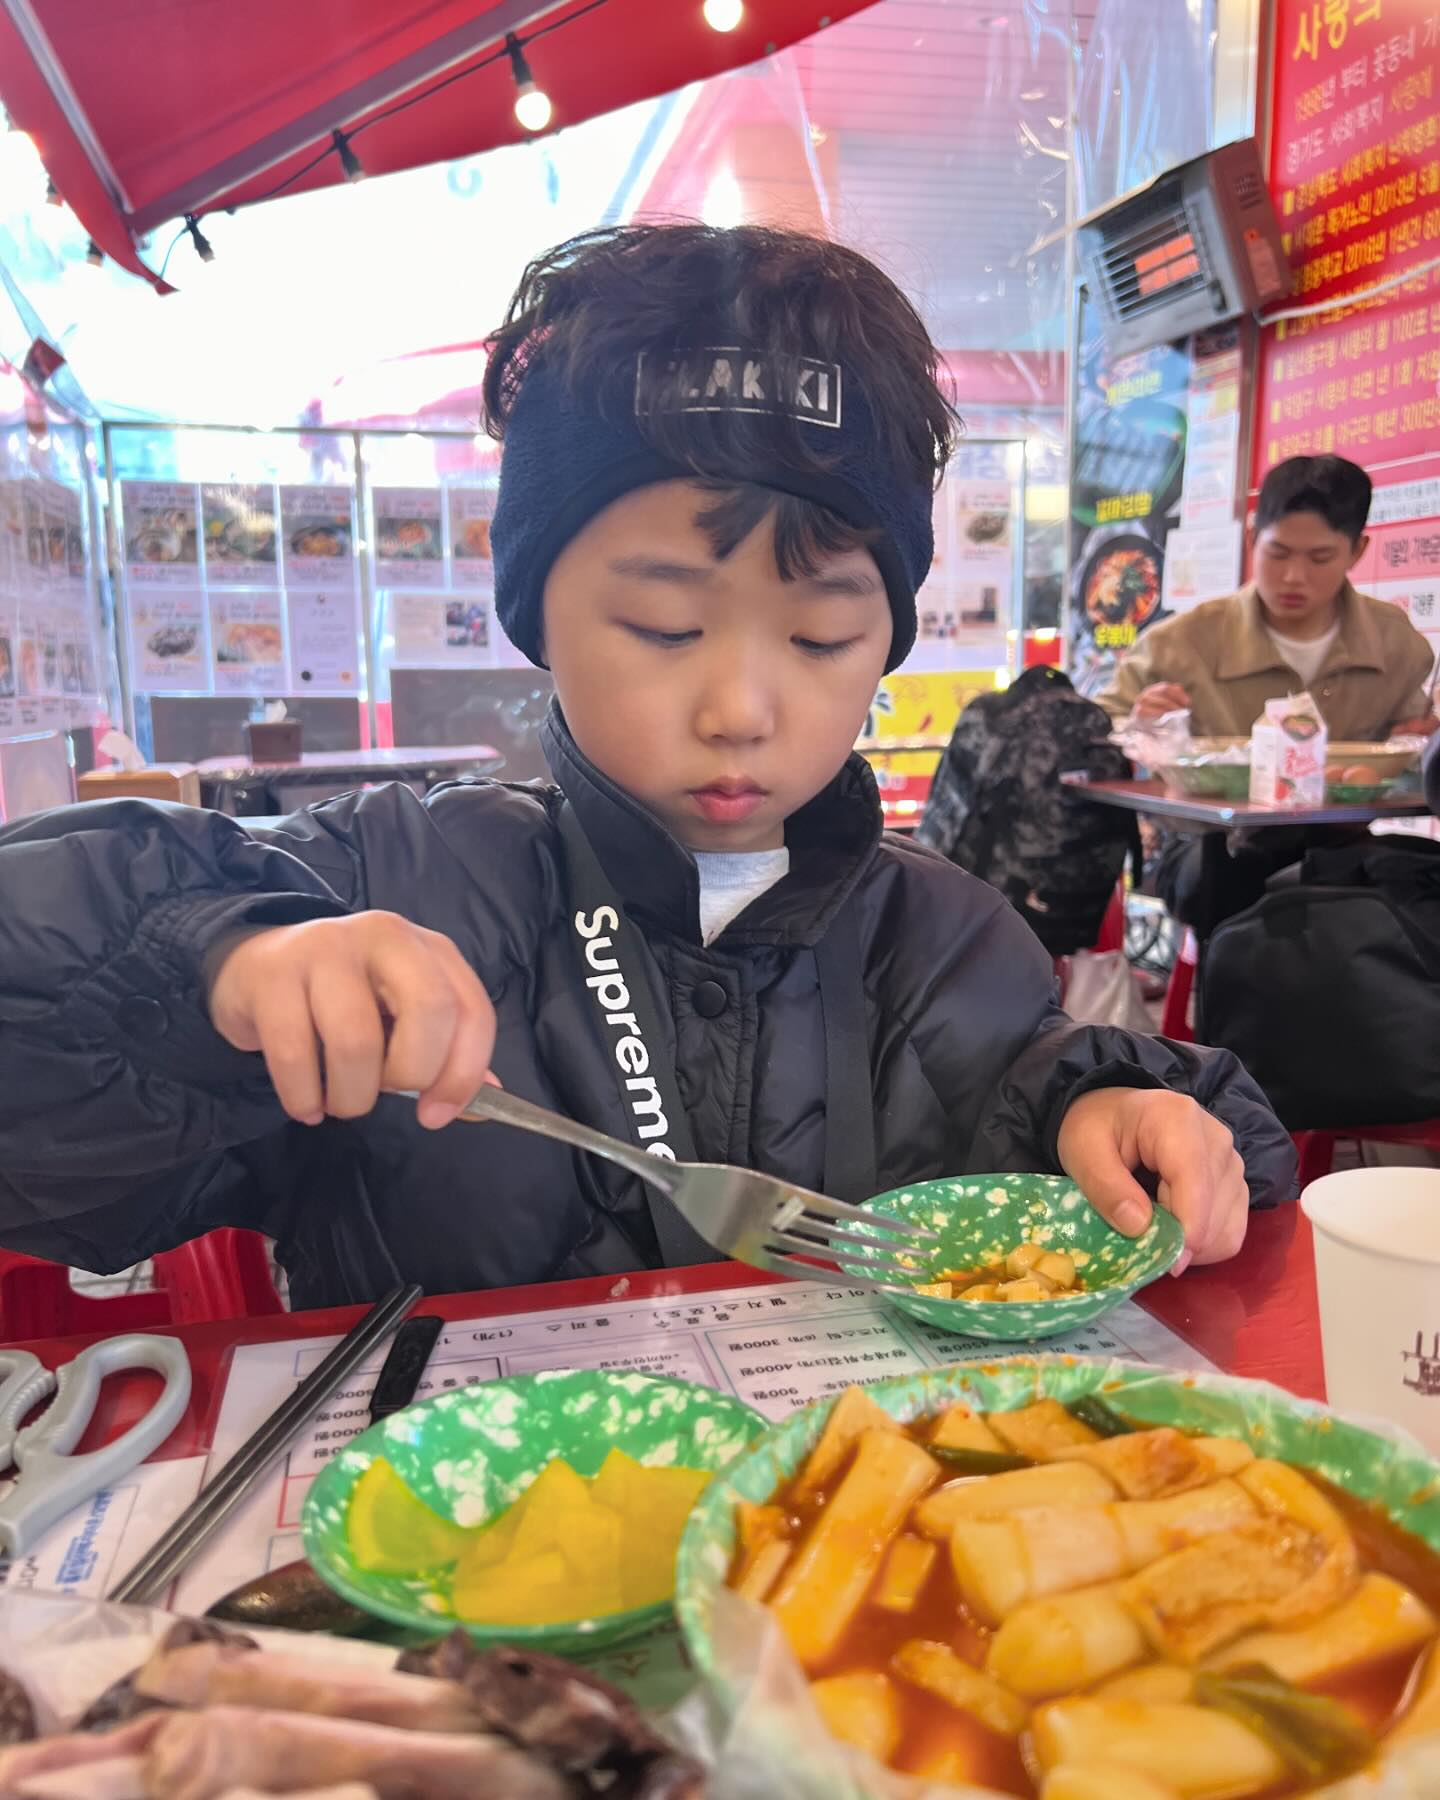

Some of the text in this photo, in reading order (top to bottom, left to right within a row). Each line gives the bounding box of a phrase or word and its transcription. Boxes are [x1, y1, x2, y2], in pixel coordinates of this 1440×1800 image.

[826, 1327, 888, 1341] 치즈스틱
[728, 1338, 781, 1353] 3000원
[739, 1363, 794, 1378] 4000원
[315, 1427, 364, 1442] 000원
